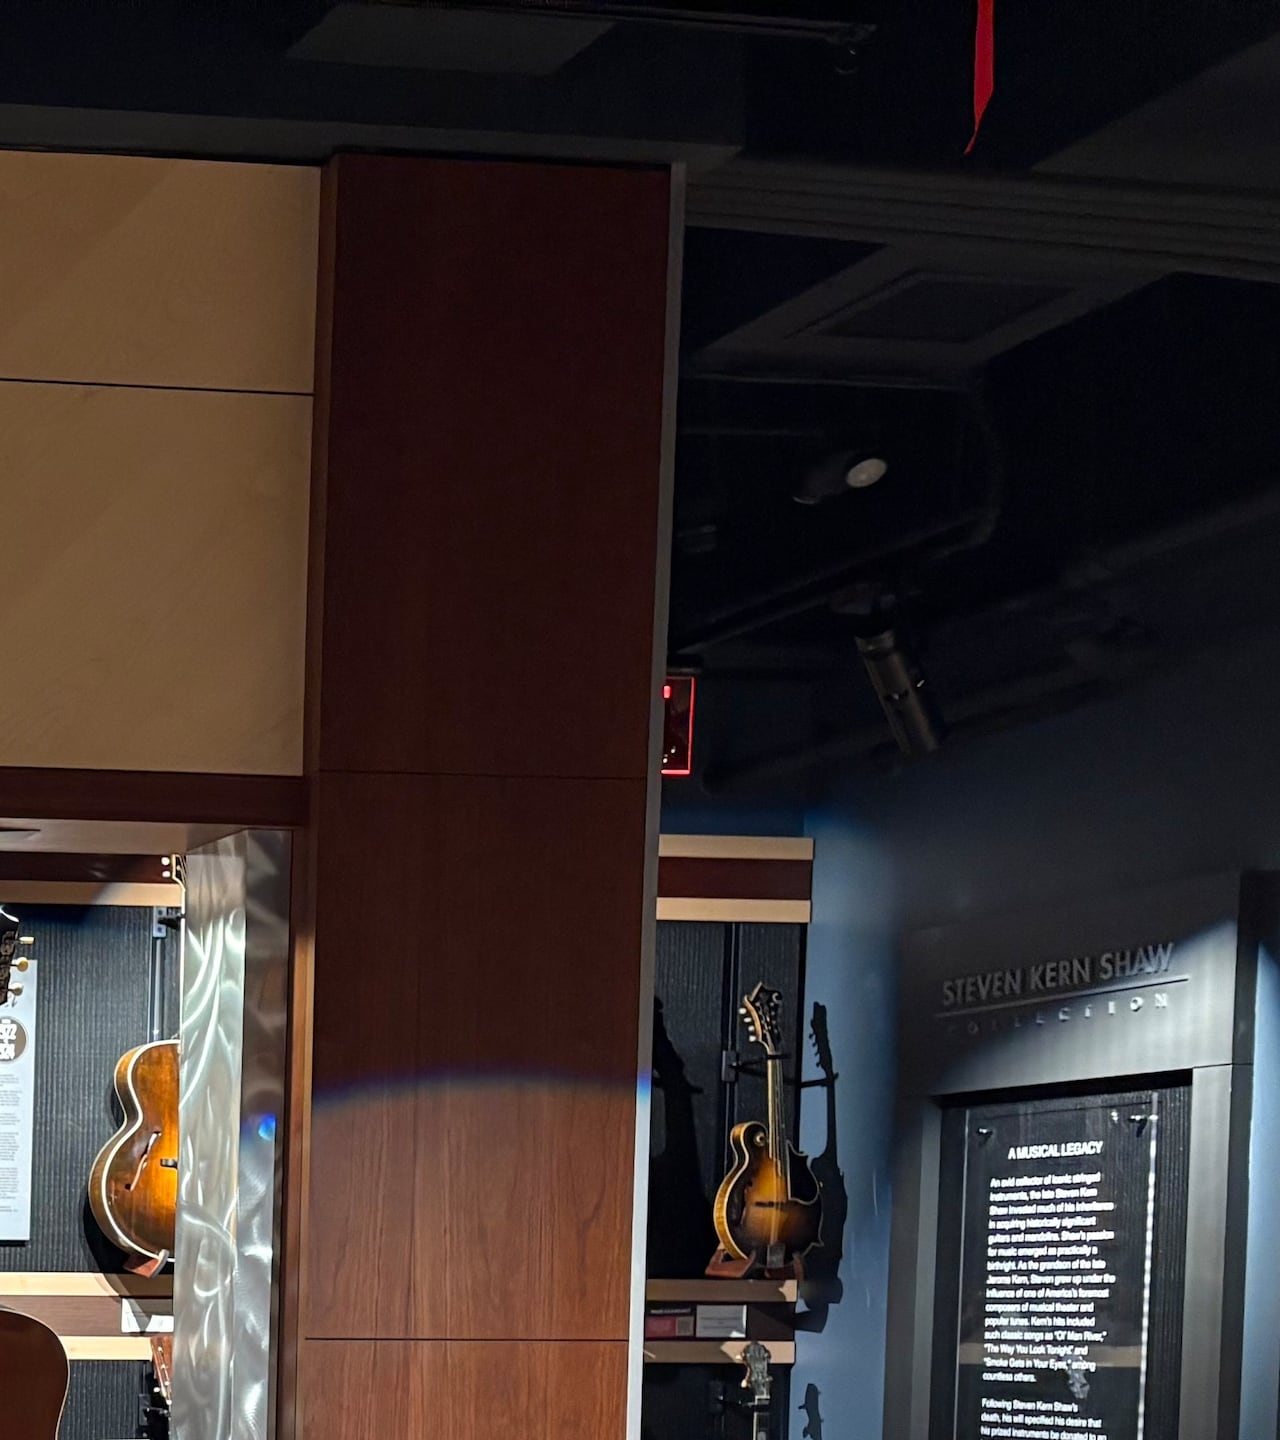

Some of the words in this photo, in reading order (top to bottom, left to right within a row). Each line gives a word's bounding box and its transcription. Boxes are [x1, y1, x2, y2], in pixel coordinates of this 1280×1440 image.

[942, 968, 1022, 1006] STEVEN
[1030, 957, 1090, 990] KERN
[1099, 943, 1174, 980] SHAW
[1008, 1147, 1016, 1159] A
[1016, 1144, 1060, 1158] MUSICAL
[1060, 1141, 1102, 1155] LEGACY
